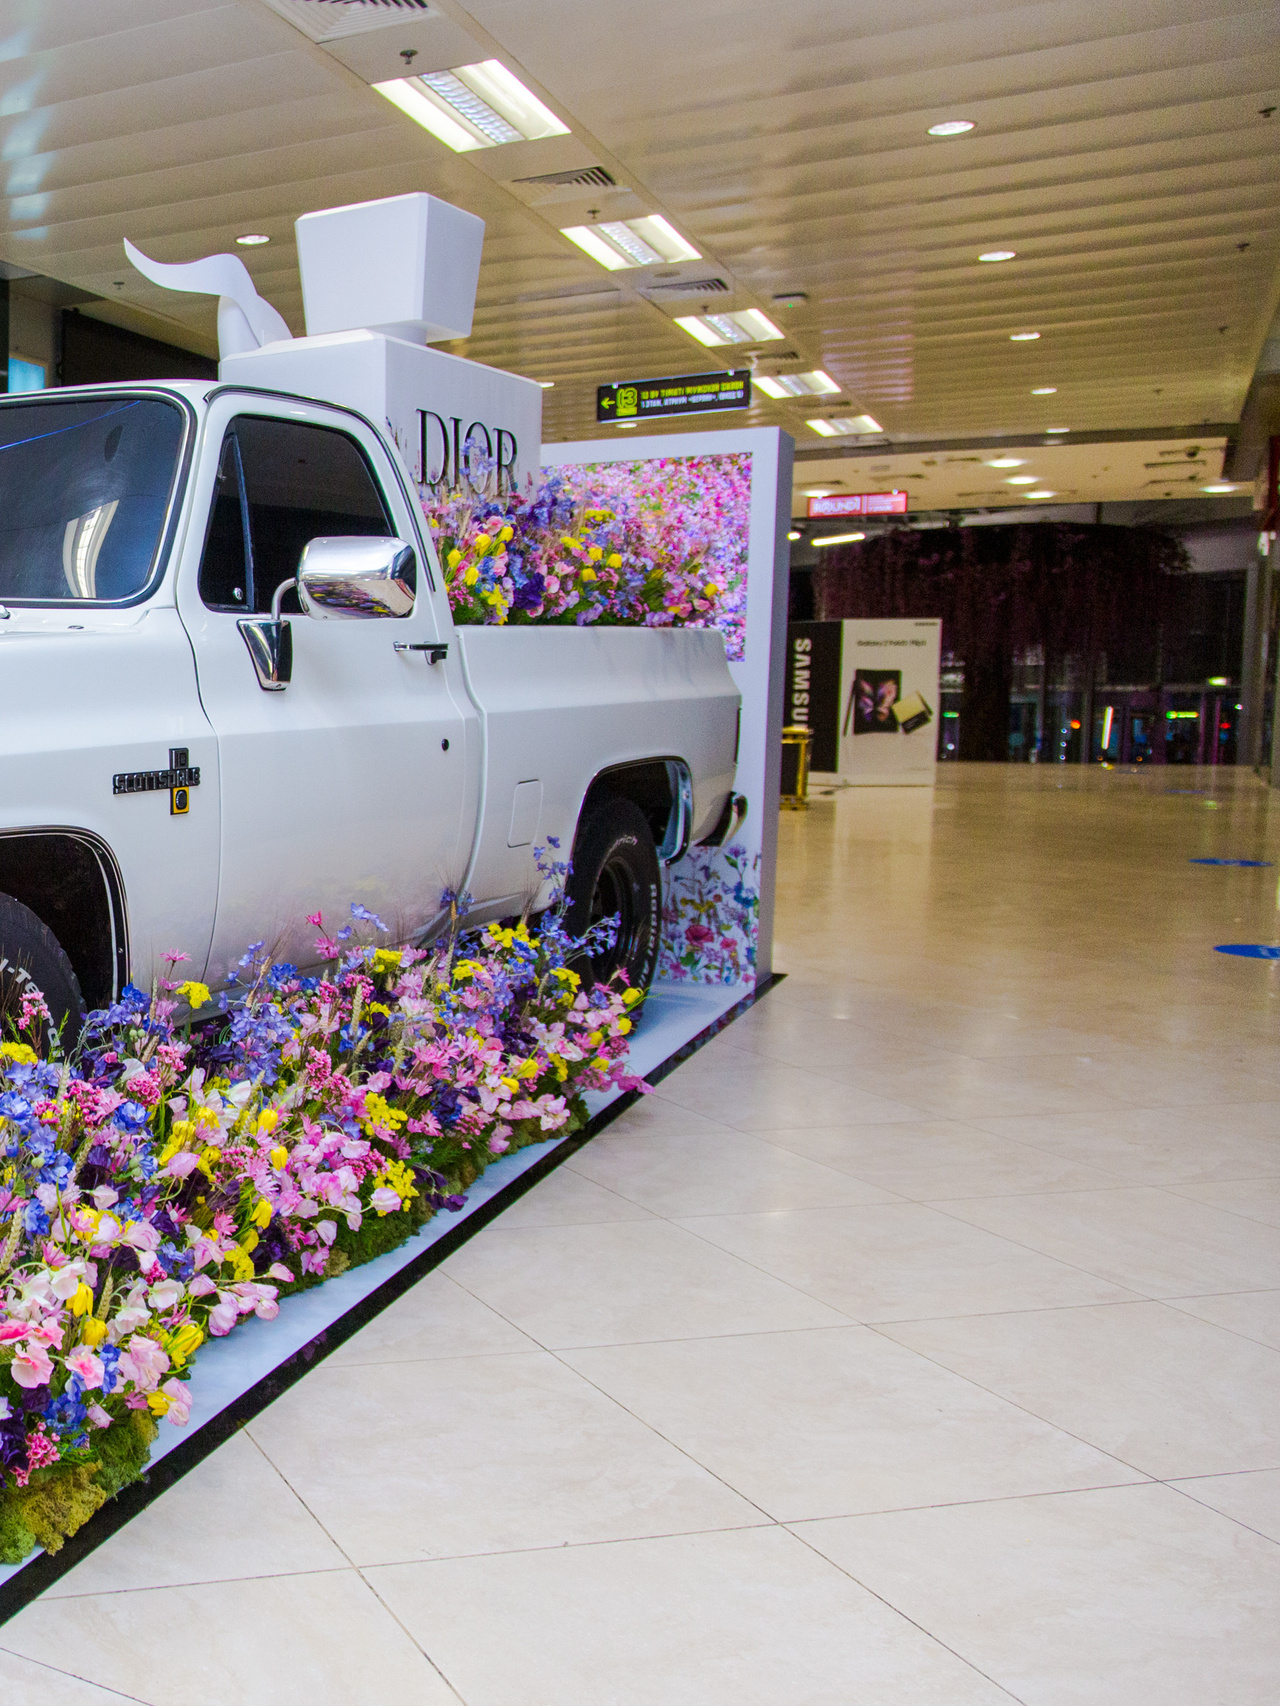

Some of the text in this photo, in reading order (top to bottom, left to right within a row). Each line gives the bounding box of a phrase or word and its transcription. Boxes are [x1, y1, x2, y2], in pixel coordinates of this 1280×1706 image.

[416, 408, 517, 497] DIOR
[792, 637, 812, 728] SAMSU
[113, 767, 200, 795] SCOTTSDALE
